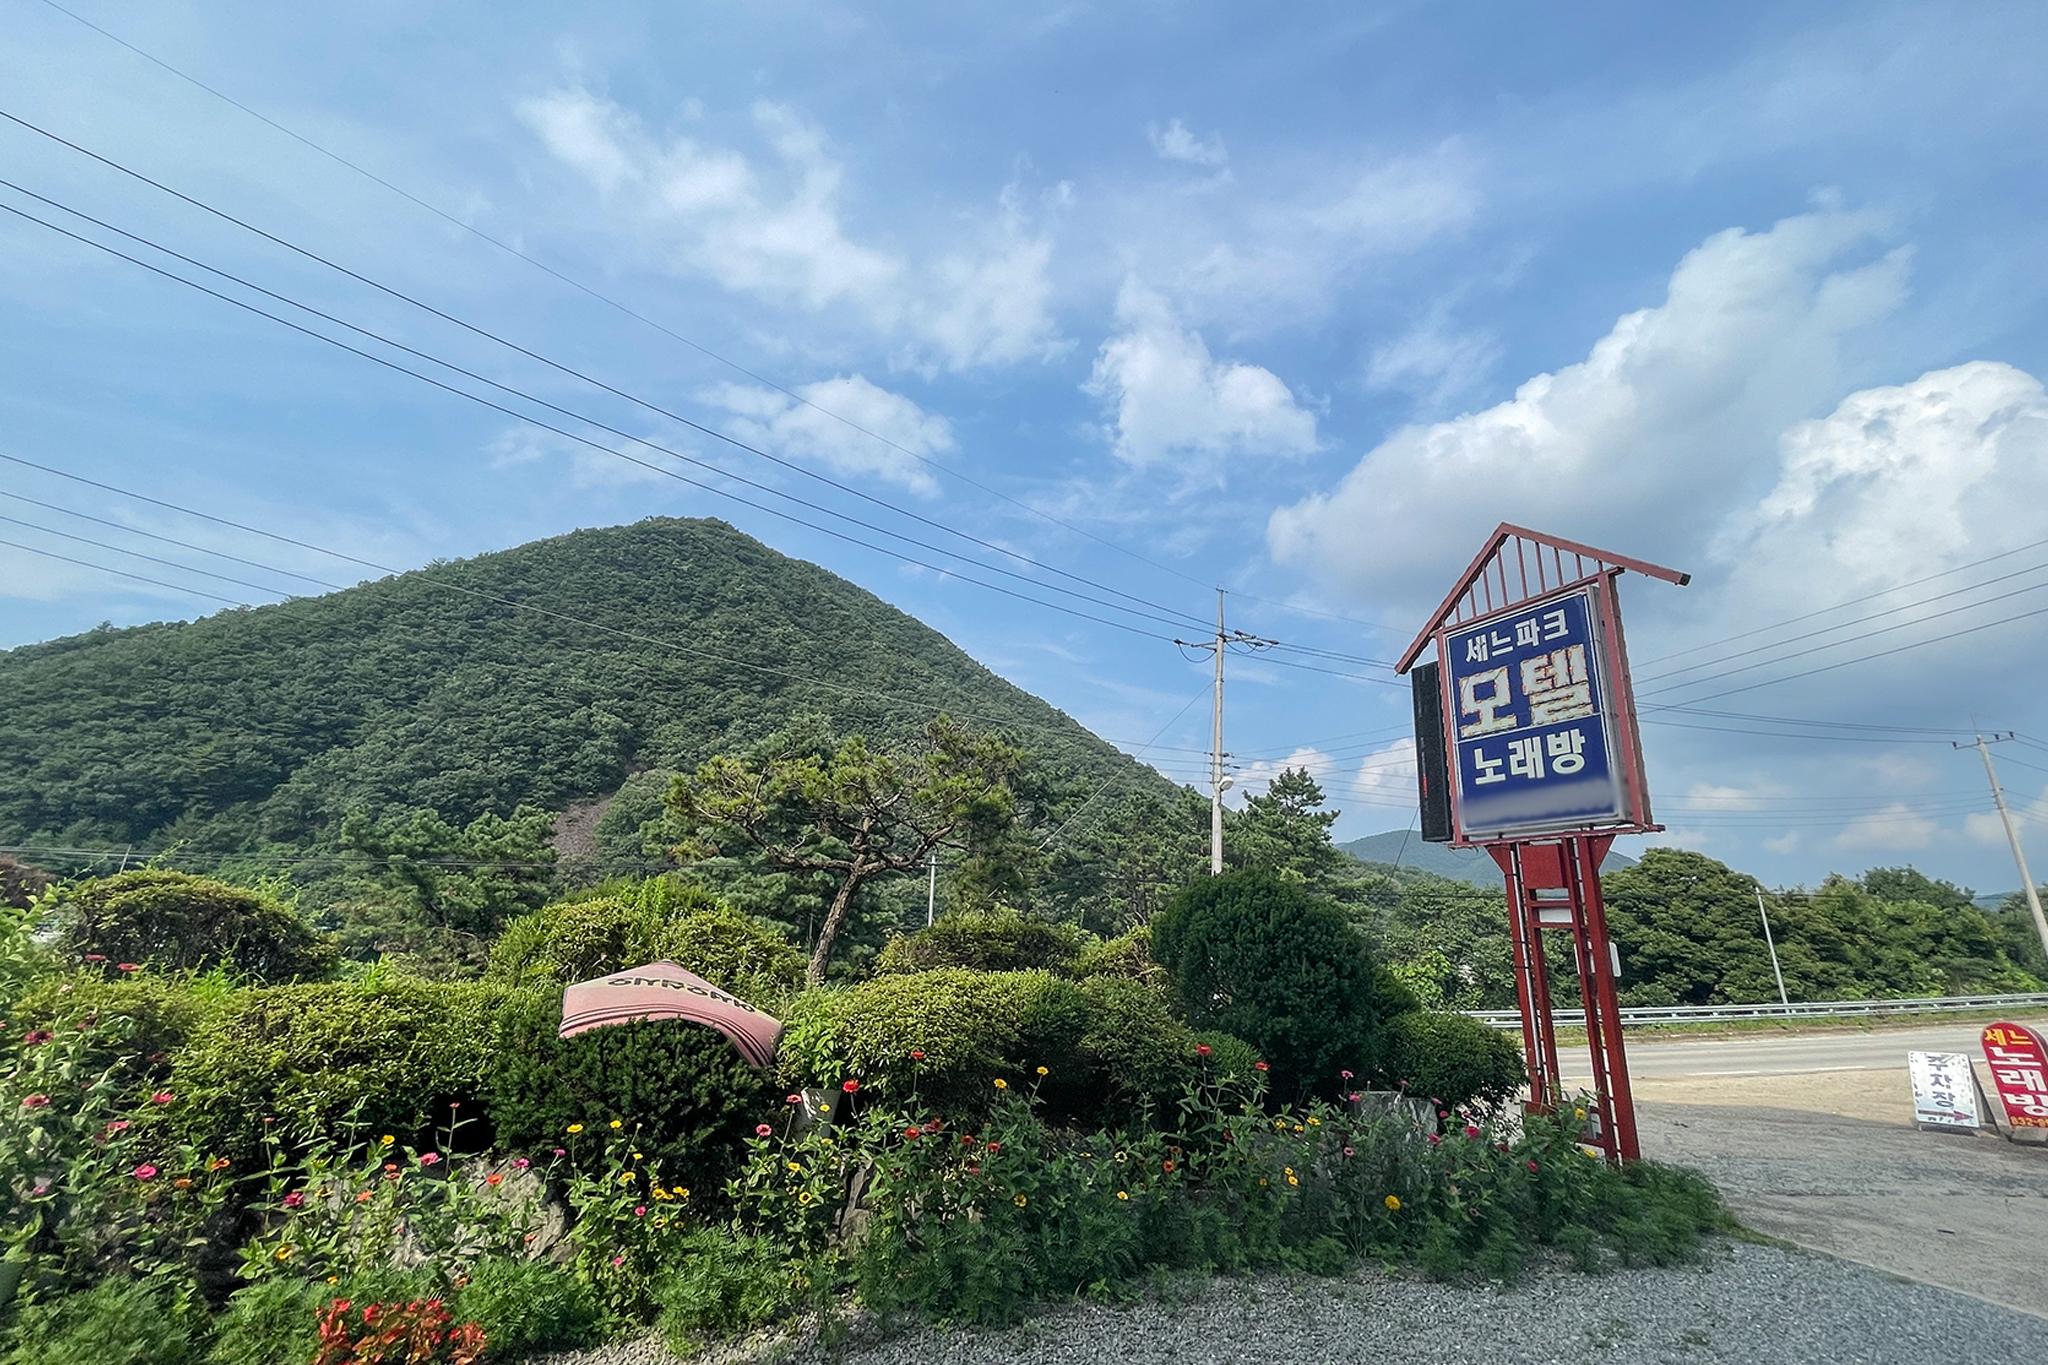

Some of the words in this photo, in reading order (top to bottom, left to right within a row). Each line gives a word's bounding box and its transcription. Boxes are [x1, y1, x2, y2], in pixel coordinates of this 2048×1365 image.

[1466, 609, 1569, 663] 세느파크
[1458, 643, 1594, 738] 모텔
[1474, 728, 1586, 785] 노래방
[1926, 1055, 1955, 1108] 주차장
[1989, 1046, 2048, 1117] 노래방
